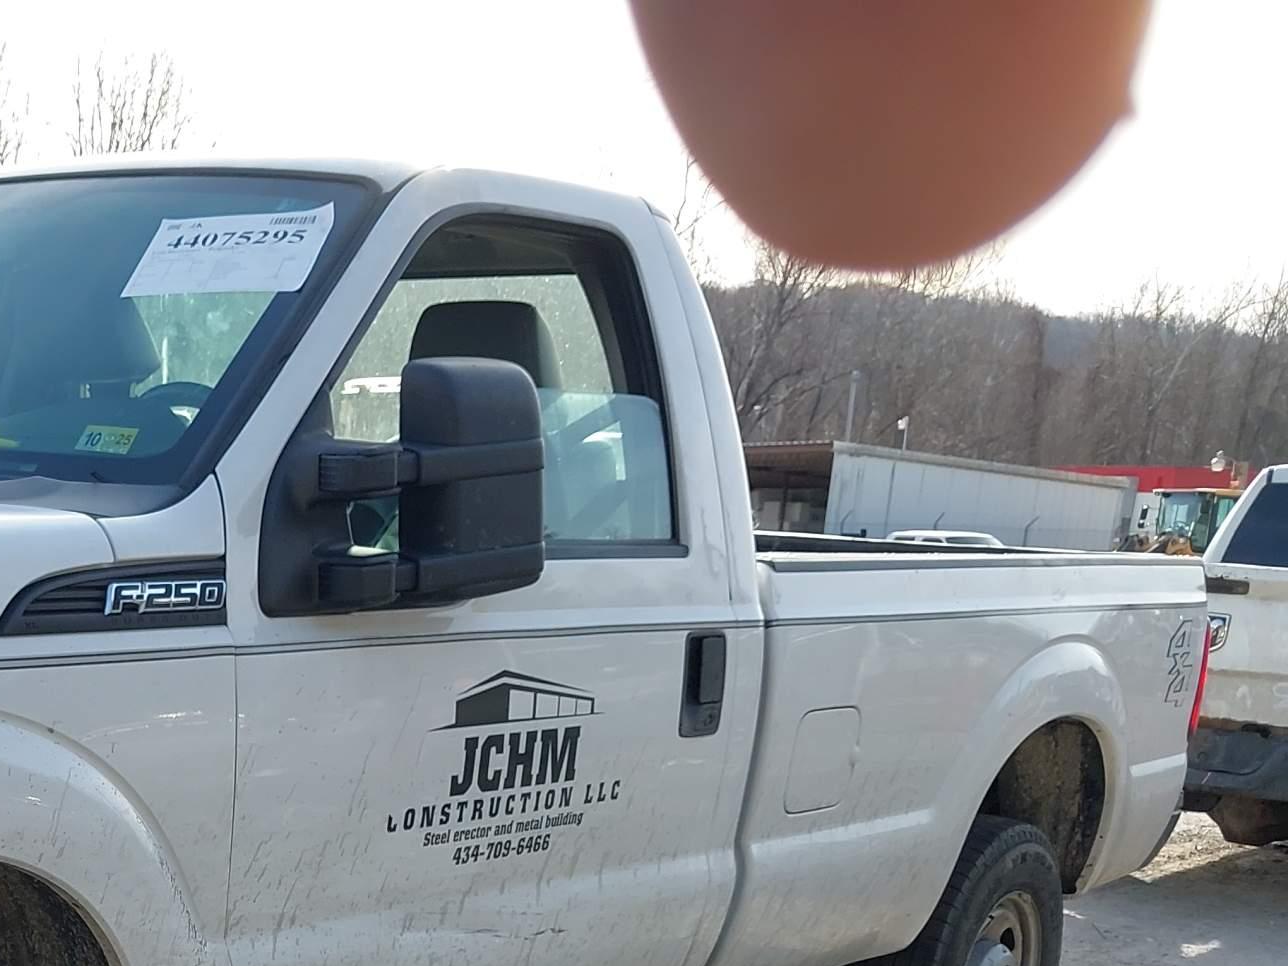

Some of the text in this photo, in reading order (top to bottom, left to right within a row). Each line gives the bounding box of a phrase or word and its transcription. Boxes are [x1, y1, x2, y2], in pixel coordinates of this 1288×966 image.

[167, 228, 308, 250] 44075295
[84, 431, 133, 447] 10 25
[104, 580, 227, 616] F-250
[449, 725, 582, 797] JCHM
[584, 780, 621, 804] LLC
[423, 811, 584, 847] Steel erector and metal building
[452, 833, 551, 866] 434-709-6466
